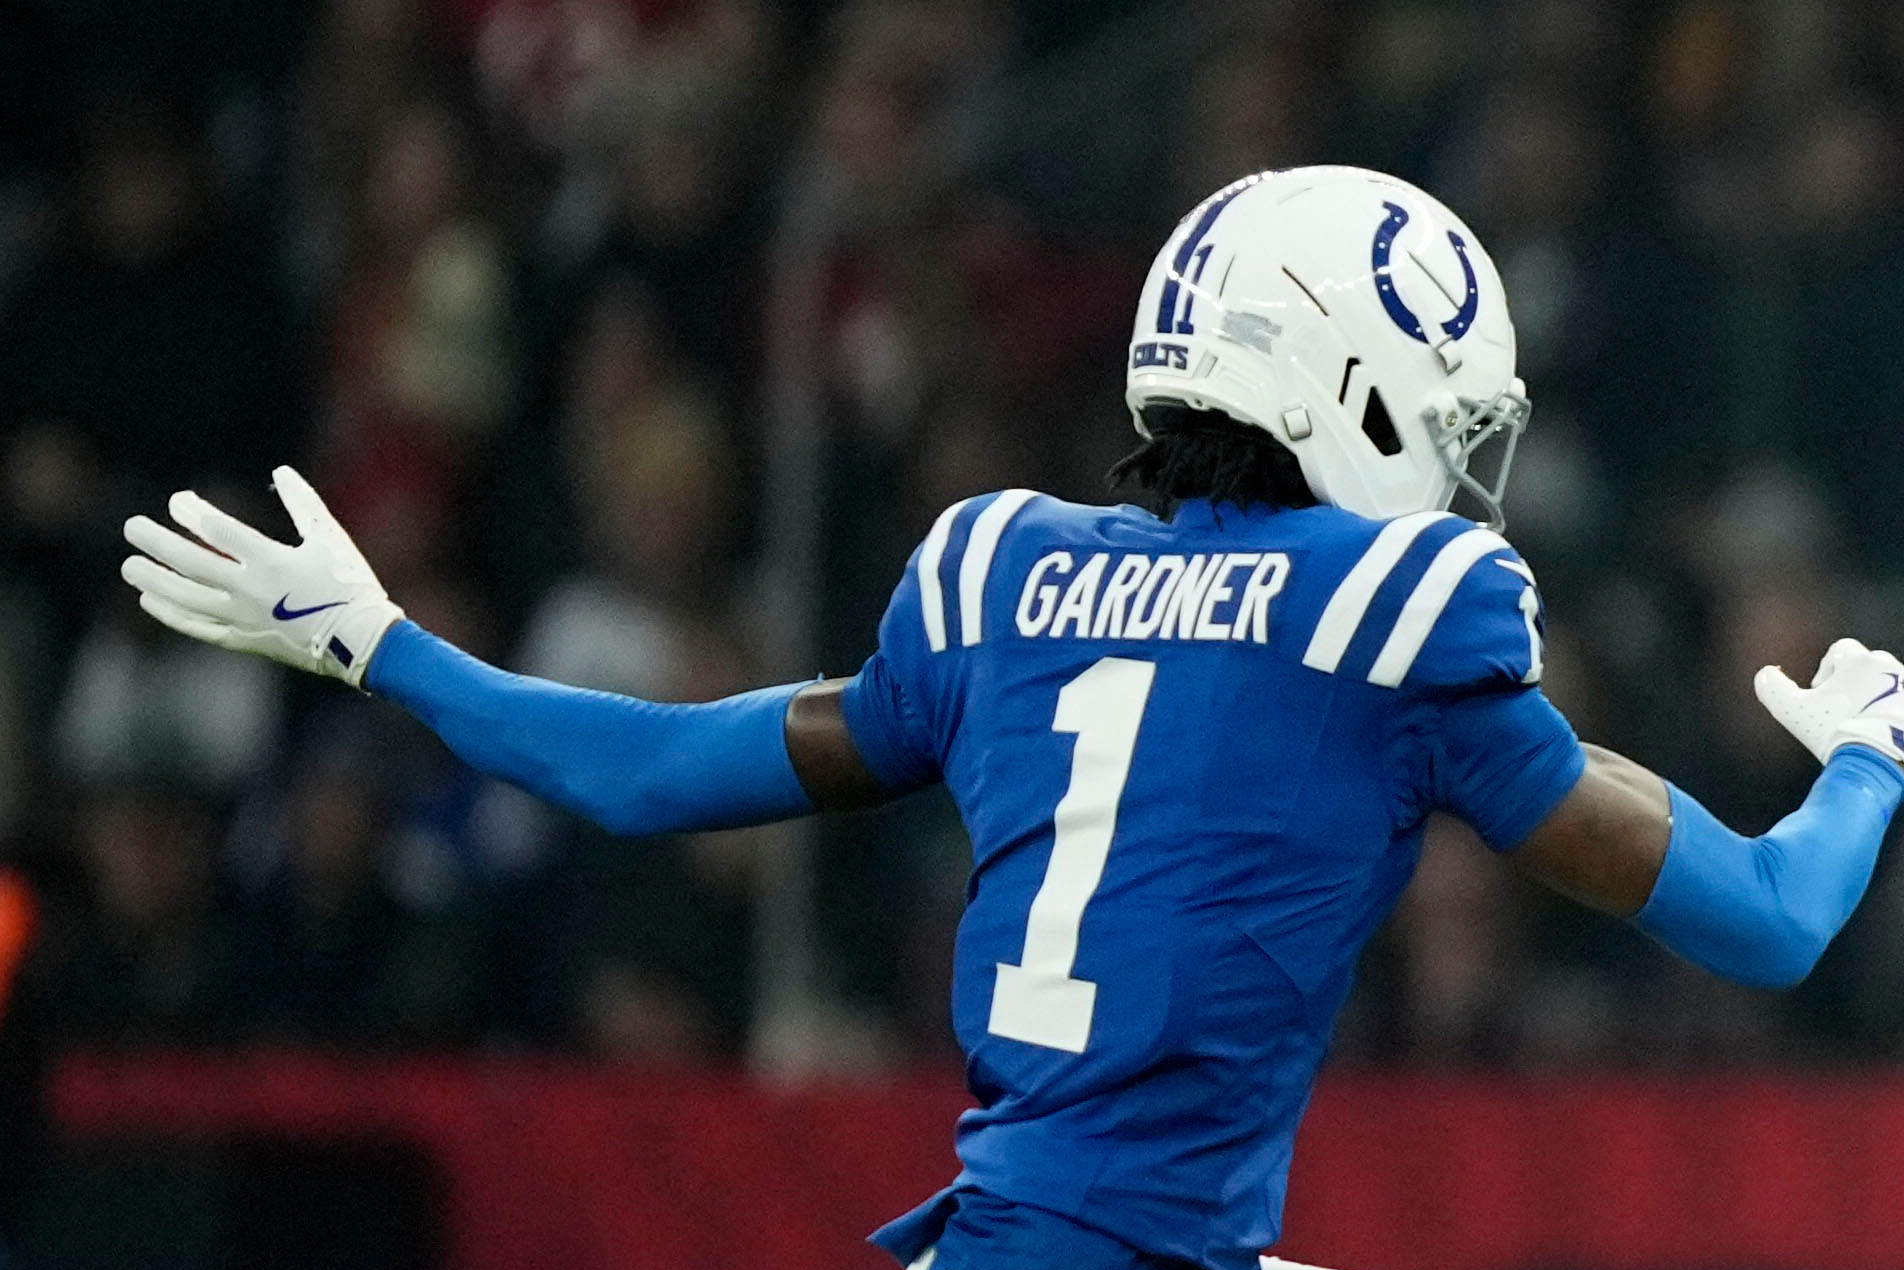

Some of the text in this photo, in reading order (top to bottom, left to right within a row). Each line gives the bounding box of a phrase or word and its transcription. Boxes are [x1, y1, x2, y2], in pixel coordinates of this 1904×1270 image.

[1015, 551, 1292, 644] GARDNER
[1518, 585, 1544, 684] 1
[987, 656, 1157, 1053] 1
